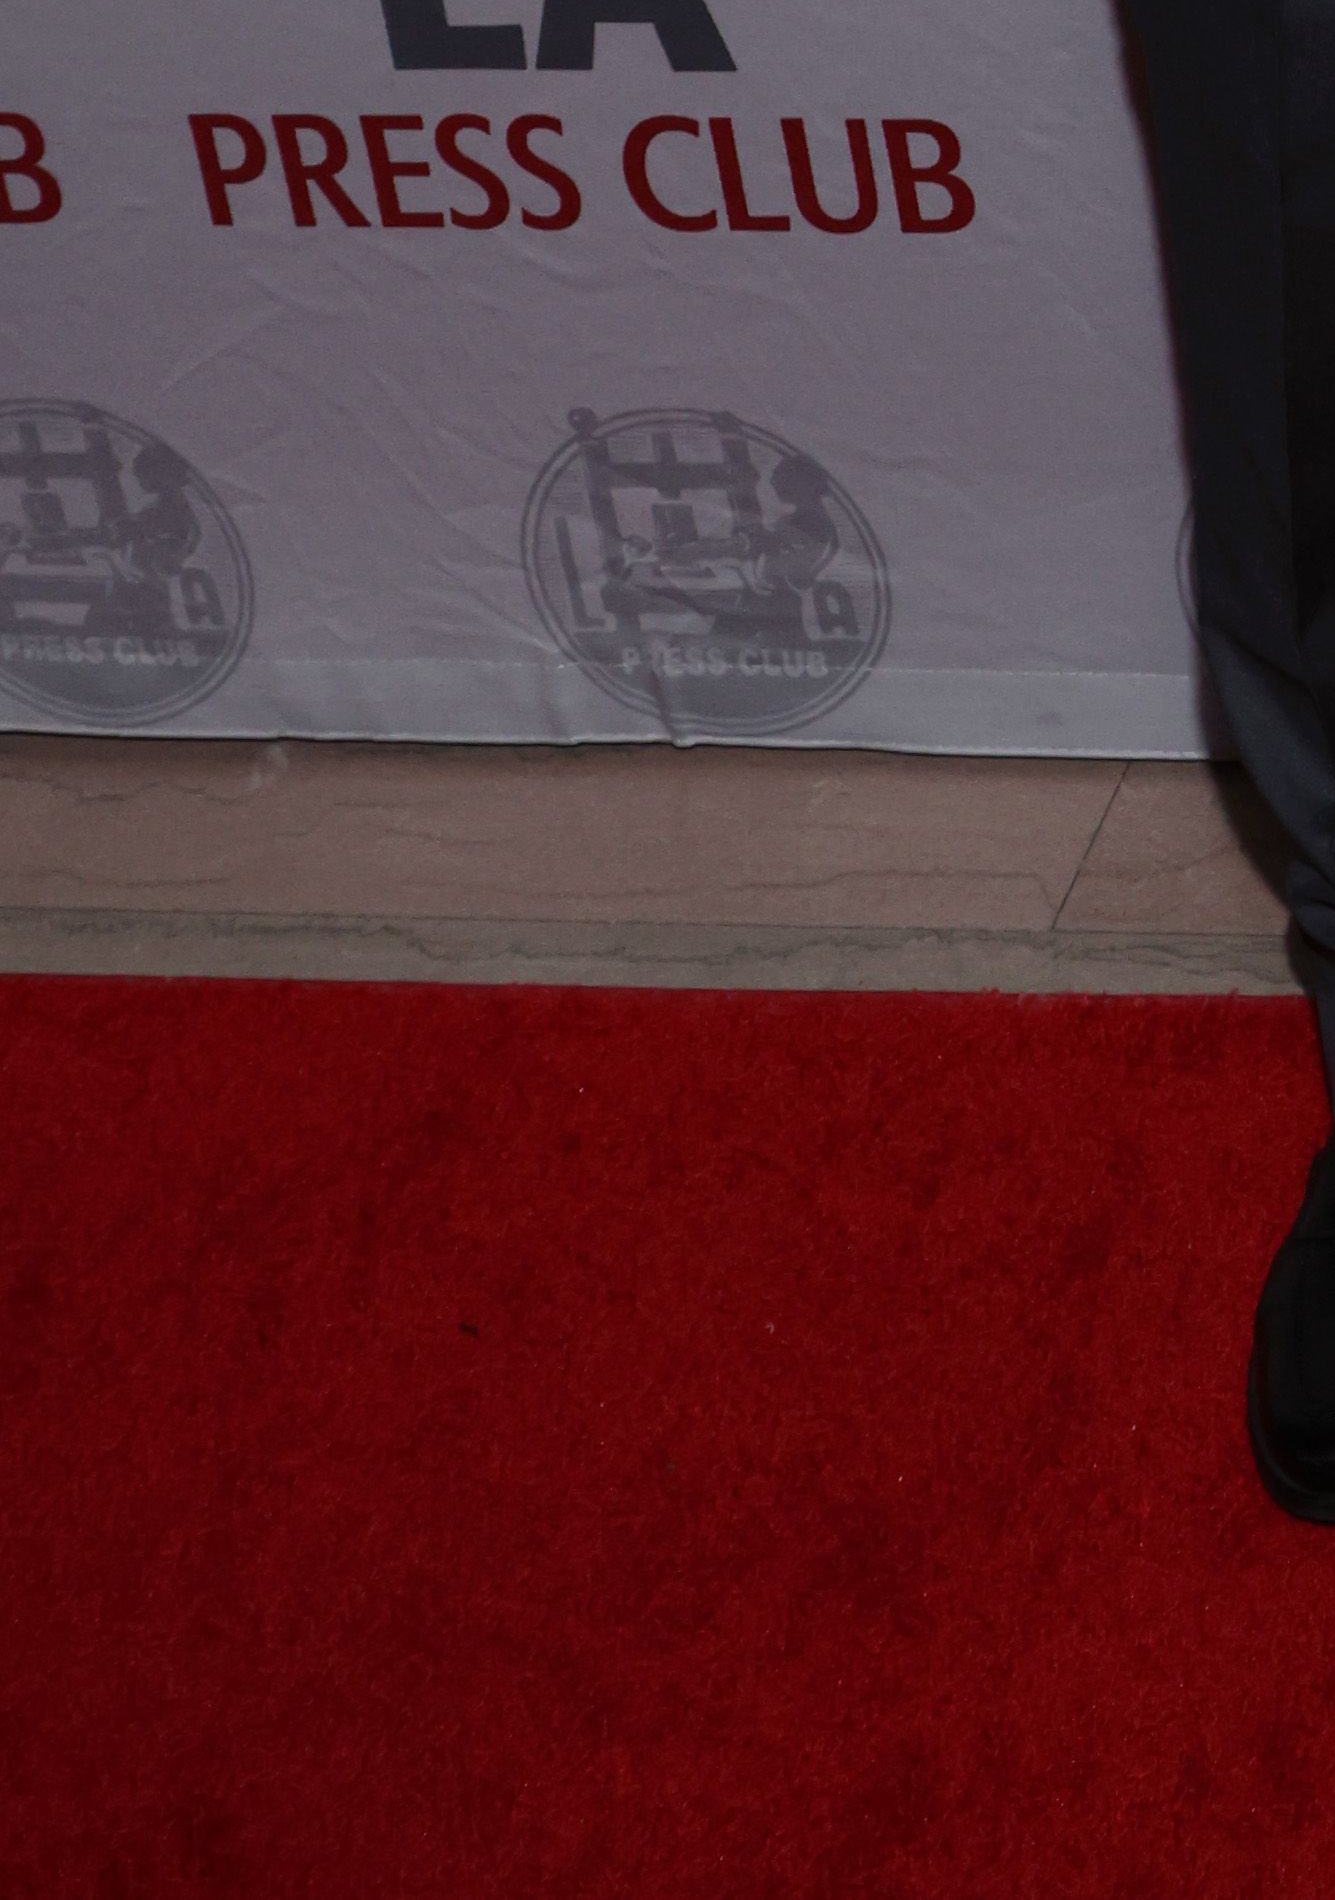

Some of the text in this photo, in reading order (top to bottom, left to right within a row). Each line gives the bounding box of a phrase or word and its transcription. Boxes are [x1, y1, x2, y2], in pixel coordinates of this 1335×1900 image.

[188, 112, 976, 235] PRESS CLUB
[113, 636, 201, 668] CLUB
[620, 645, 829, 679] PESS CLUB
